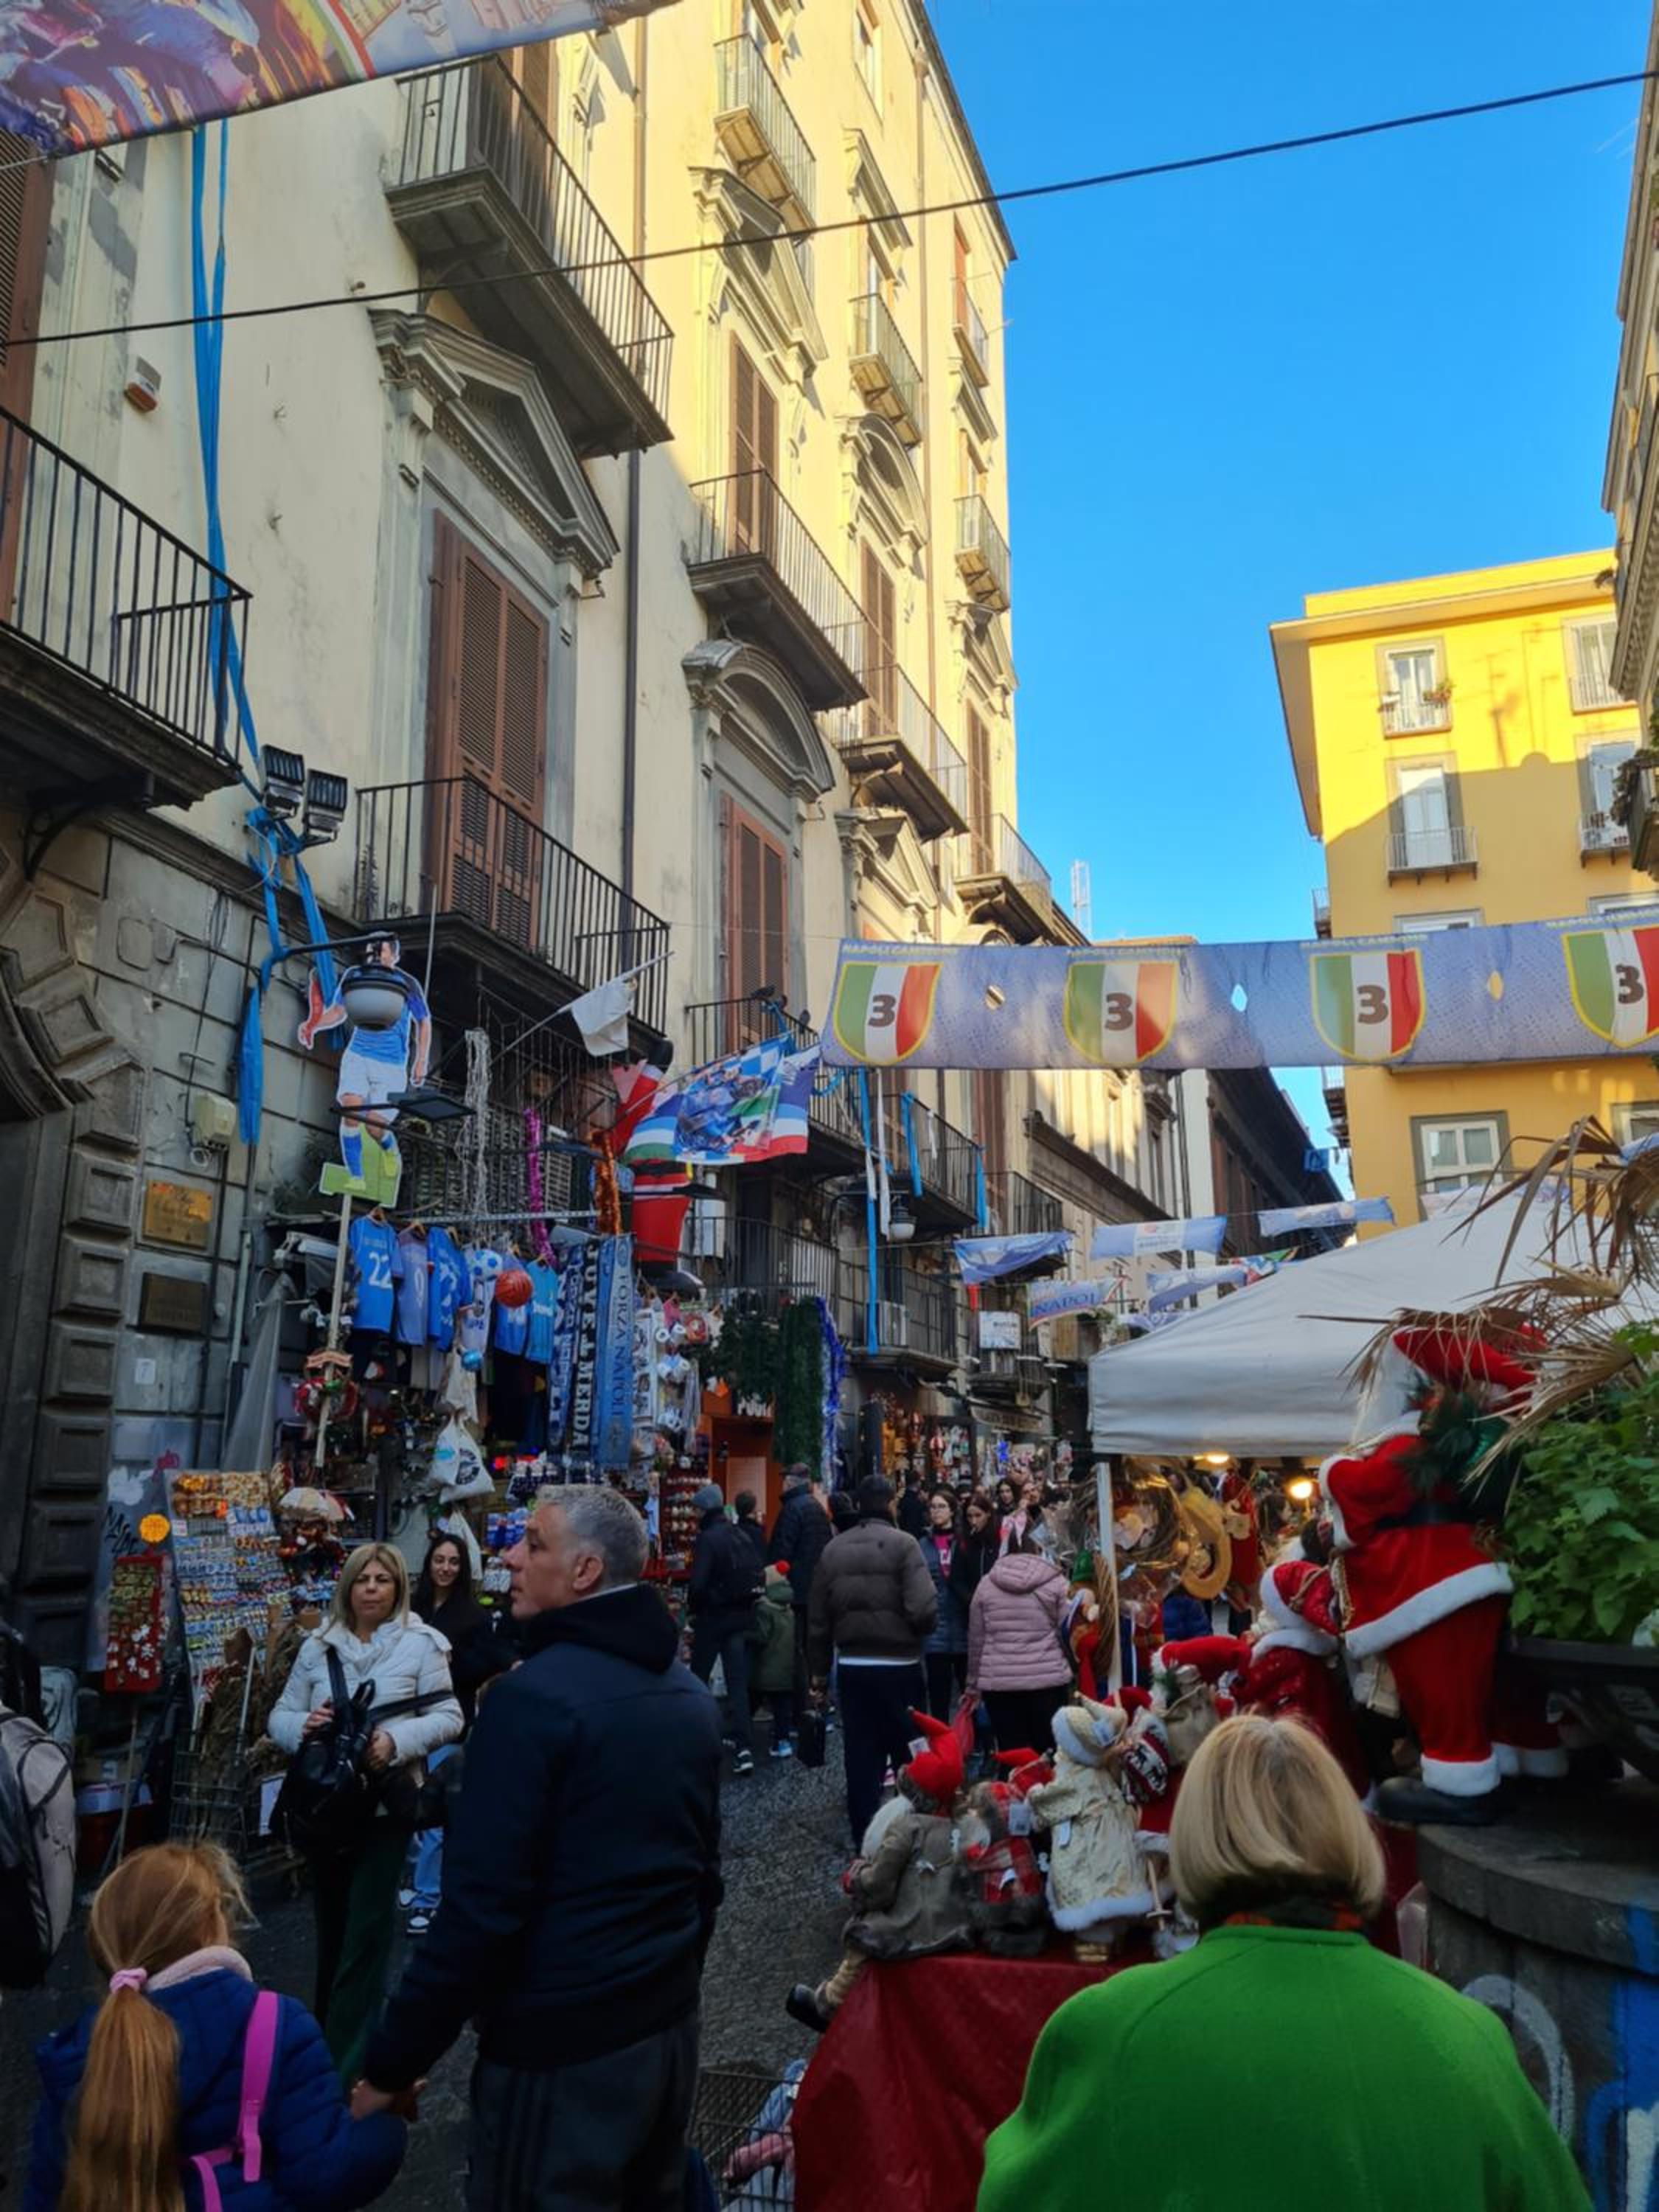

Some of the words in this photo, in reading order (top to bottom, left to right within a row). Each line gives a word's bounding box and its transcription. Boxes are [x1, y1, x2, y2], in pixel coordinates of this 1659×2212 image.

[1357, 984, 1389, 1025] 3
[1615, 963, 1645, 1005] 3
[868, 994, 897, 1028] 3
[1105, 992, 1134, 1032] 3
[369, 1251, 393, 1290] 22
[581, 1244, 599, 1329] JUVE
[615, 1273, 628, 1340] FORZA
[611, 1345, 627, 1416] NAPOLI
[571, 1360, 594, 1447] MERDA
